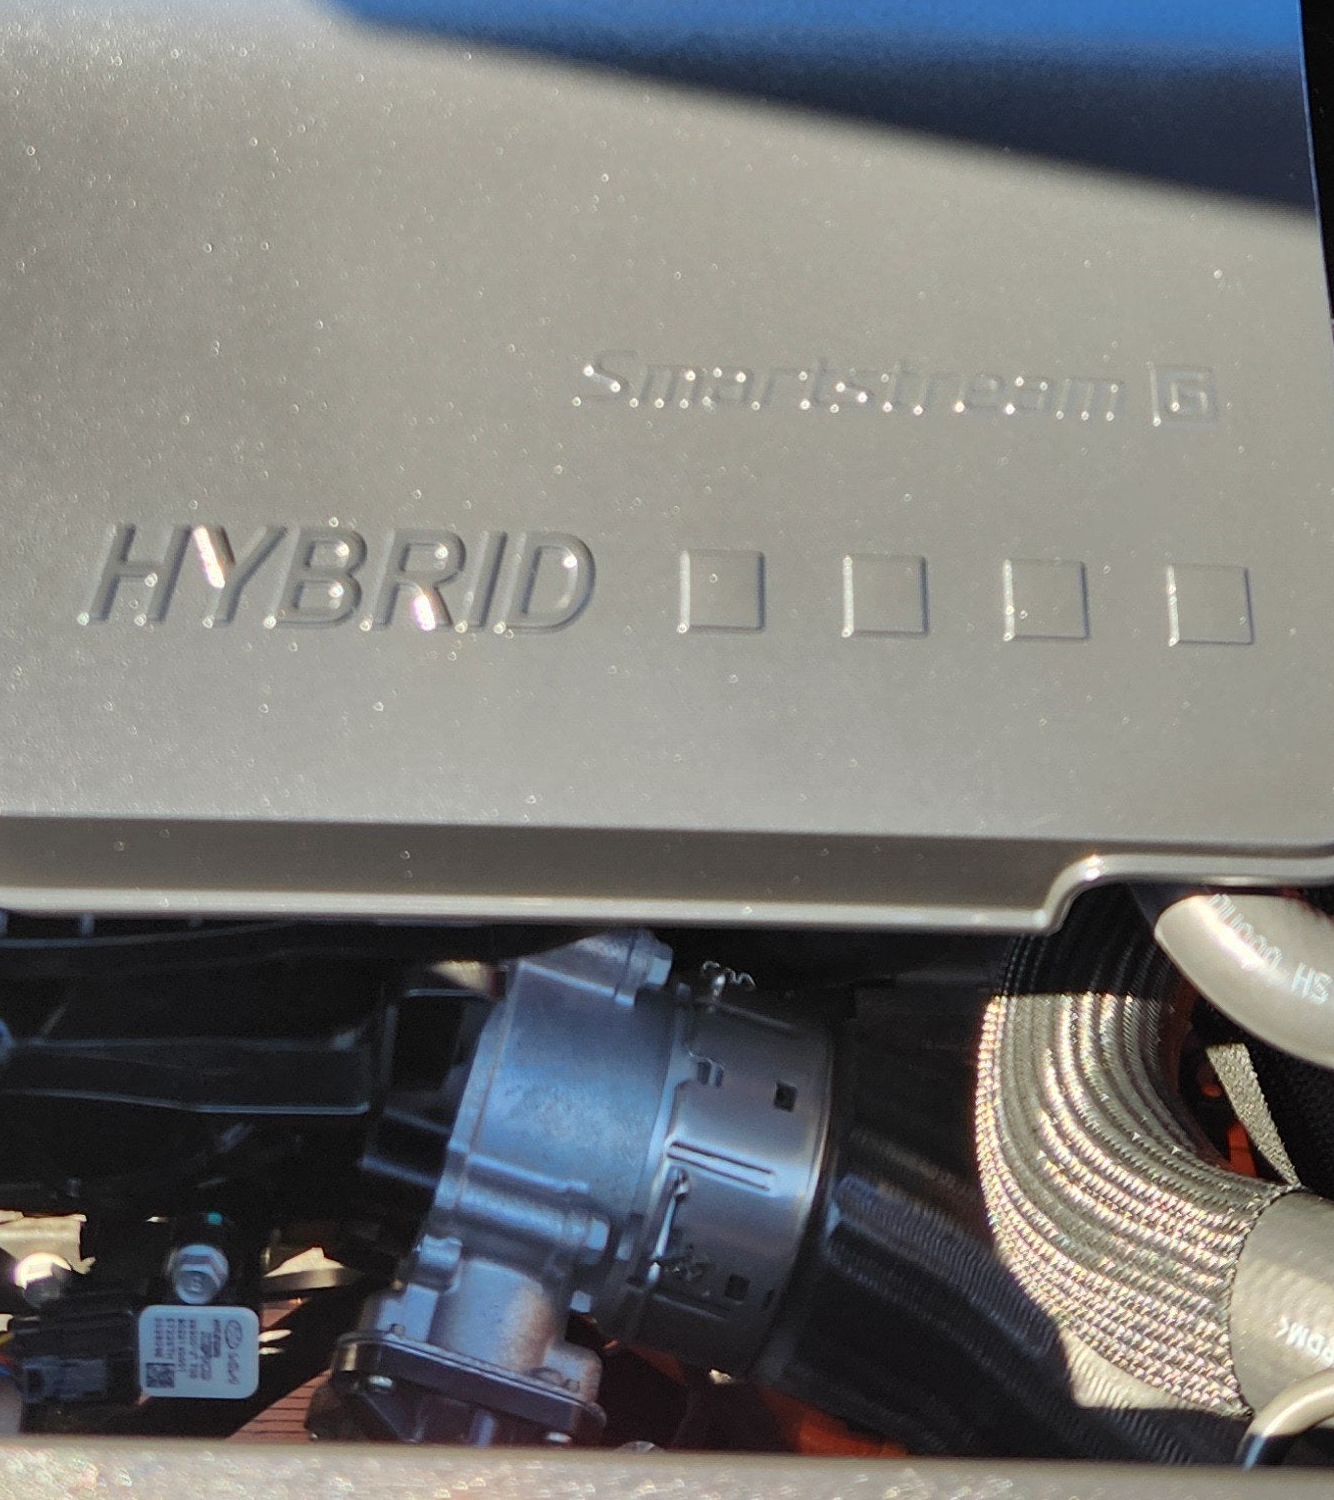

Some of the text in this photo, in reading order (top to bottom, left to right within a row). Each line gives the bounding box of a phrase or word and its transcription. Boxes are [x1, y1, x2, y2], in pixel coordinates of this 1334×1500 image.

[575, 351, 1124, 419] Smartstream
[79, 521, 599, 635] HYBRID
[1292, 964, 1329, 1004] HS
